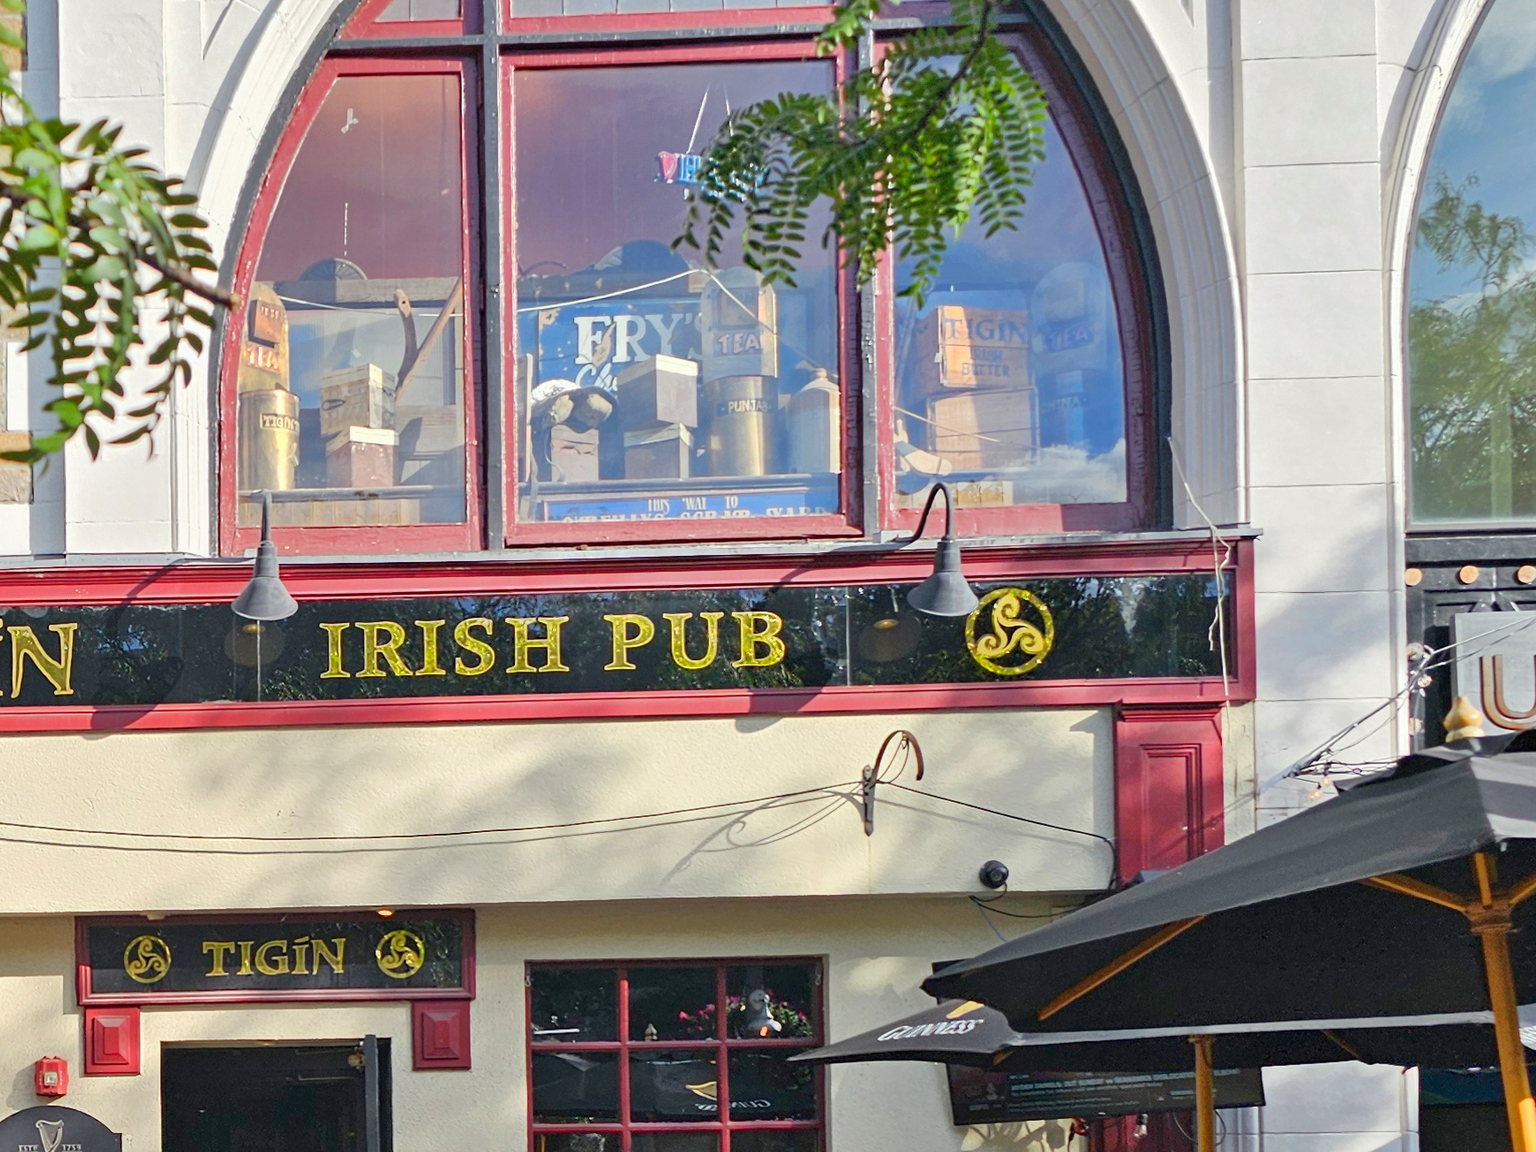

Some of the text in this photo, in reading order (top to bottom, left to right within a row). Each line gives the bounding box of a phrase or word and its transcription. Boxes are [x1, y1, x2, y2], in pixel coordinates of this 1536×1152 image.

[718, 332, 764, 355] TEA
[728, 399, 768, 414] PUNJAB
[319, 611, 786, 679] IRISH PUB
[877, 1019, 984, 1042] GUINNESS
